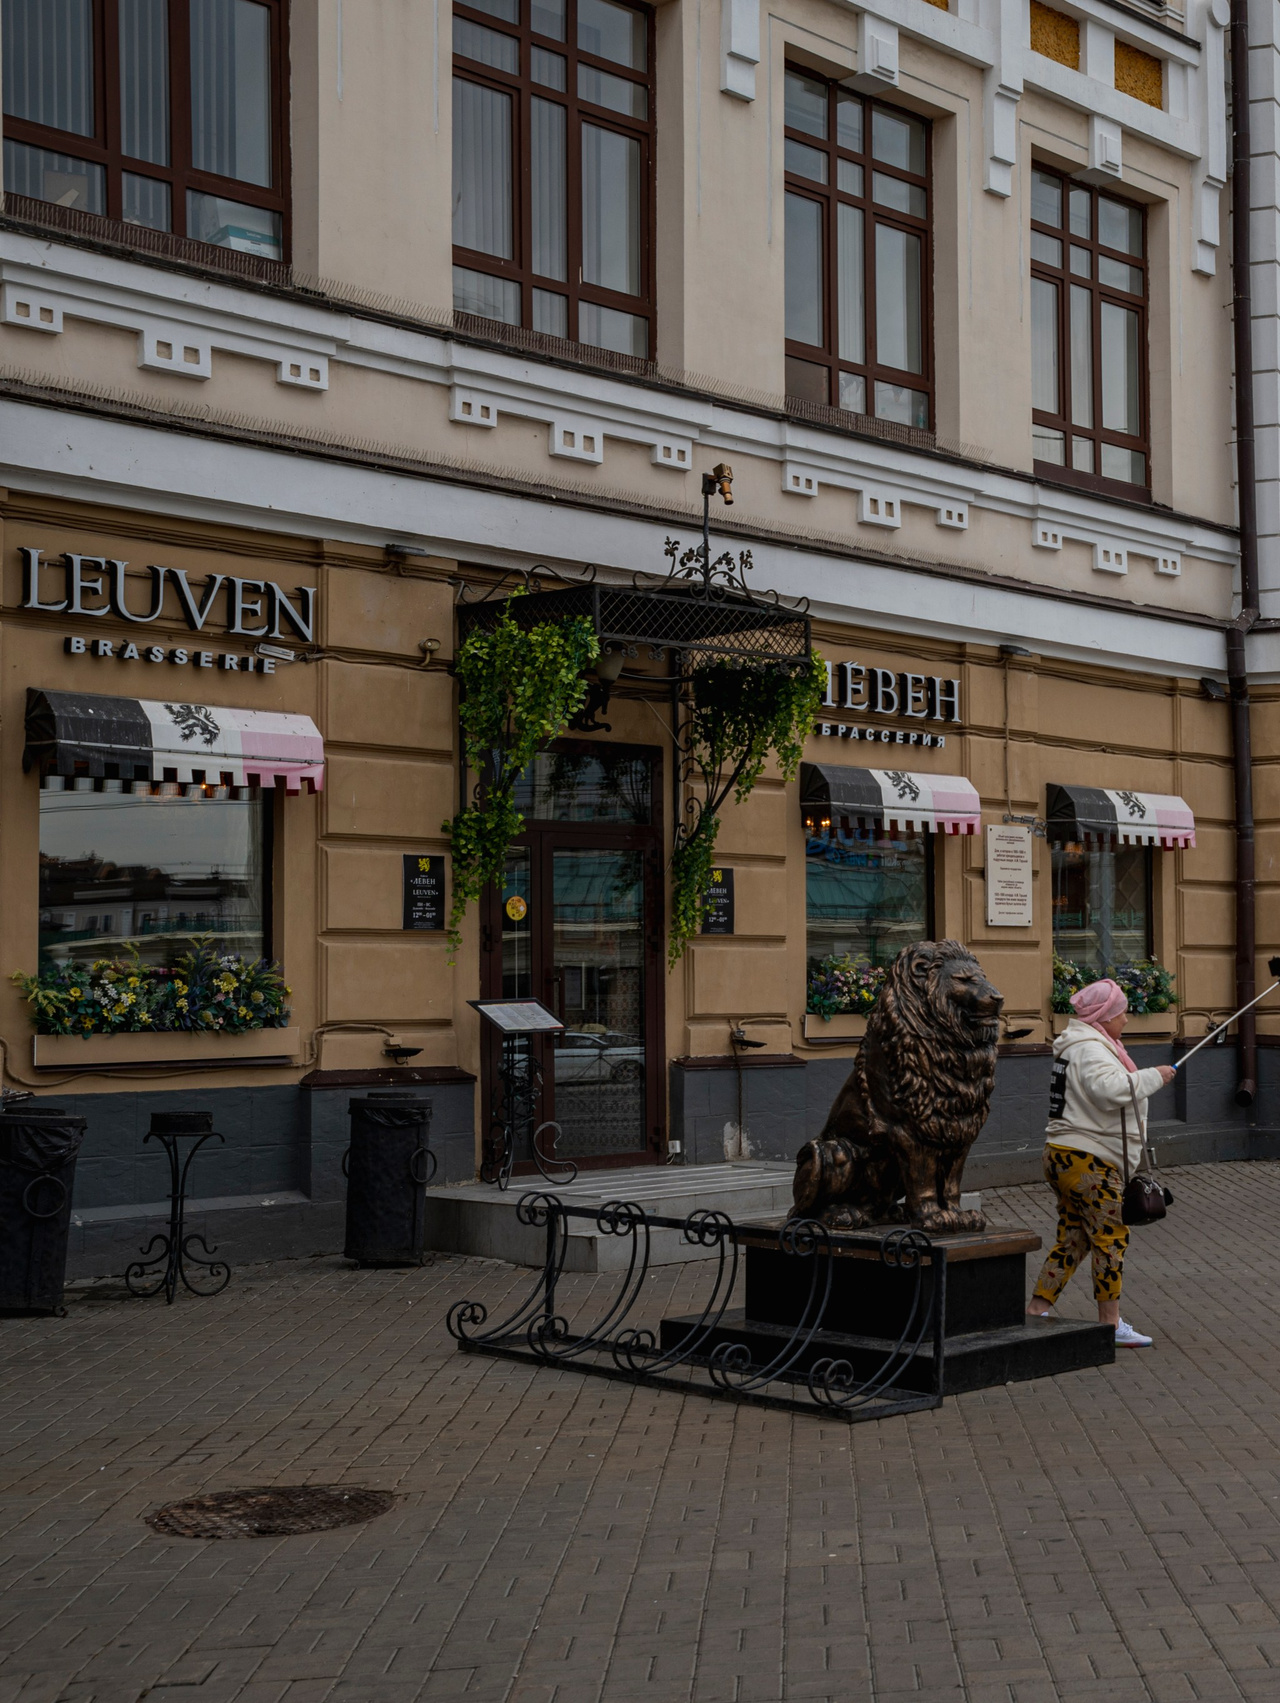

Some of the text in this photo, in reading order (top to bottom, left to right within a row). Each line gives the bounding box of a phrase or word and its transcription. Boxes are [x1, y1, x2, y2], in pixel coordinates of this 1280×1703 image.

[17, 546, 317, 642] LEUVEN
[65, 636, 276, 674] BRASSERIE
[820, 722, 946, 748] БРАССЕРИЯ
